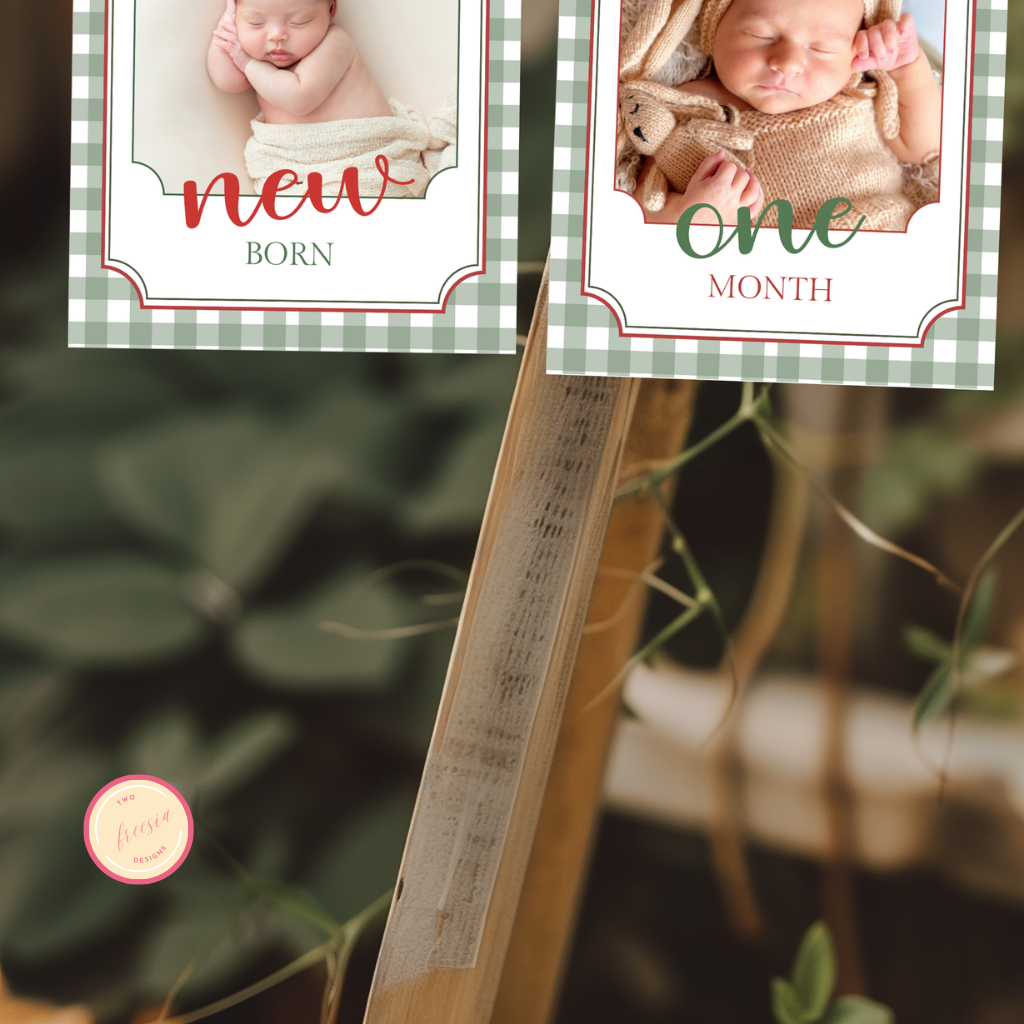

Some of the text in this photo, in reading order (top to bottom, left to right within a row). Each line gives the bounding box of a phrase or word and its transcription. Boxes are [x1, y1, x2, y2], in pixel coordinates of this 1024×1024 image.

[182, 154, 415, 230] new
[675, 195, 867, 260] one
[245, 241, 334, 267] BORN
[708, 273, 833, 303] MONTH
